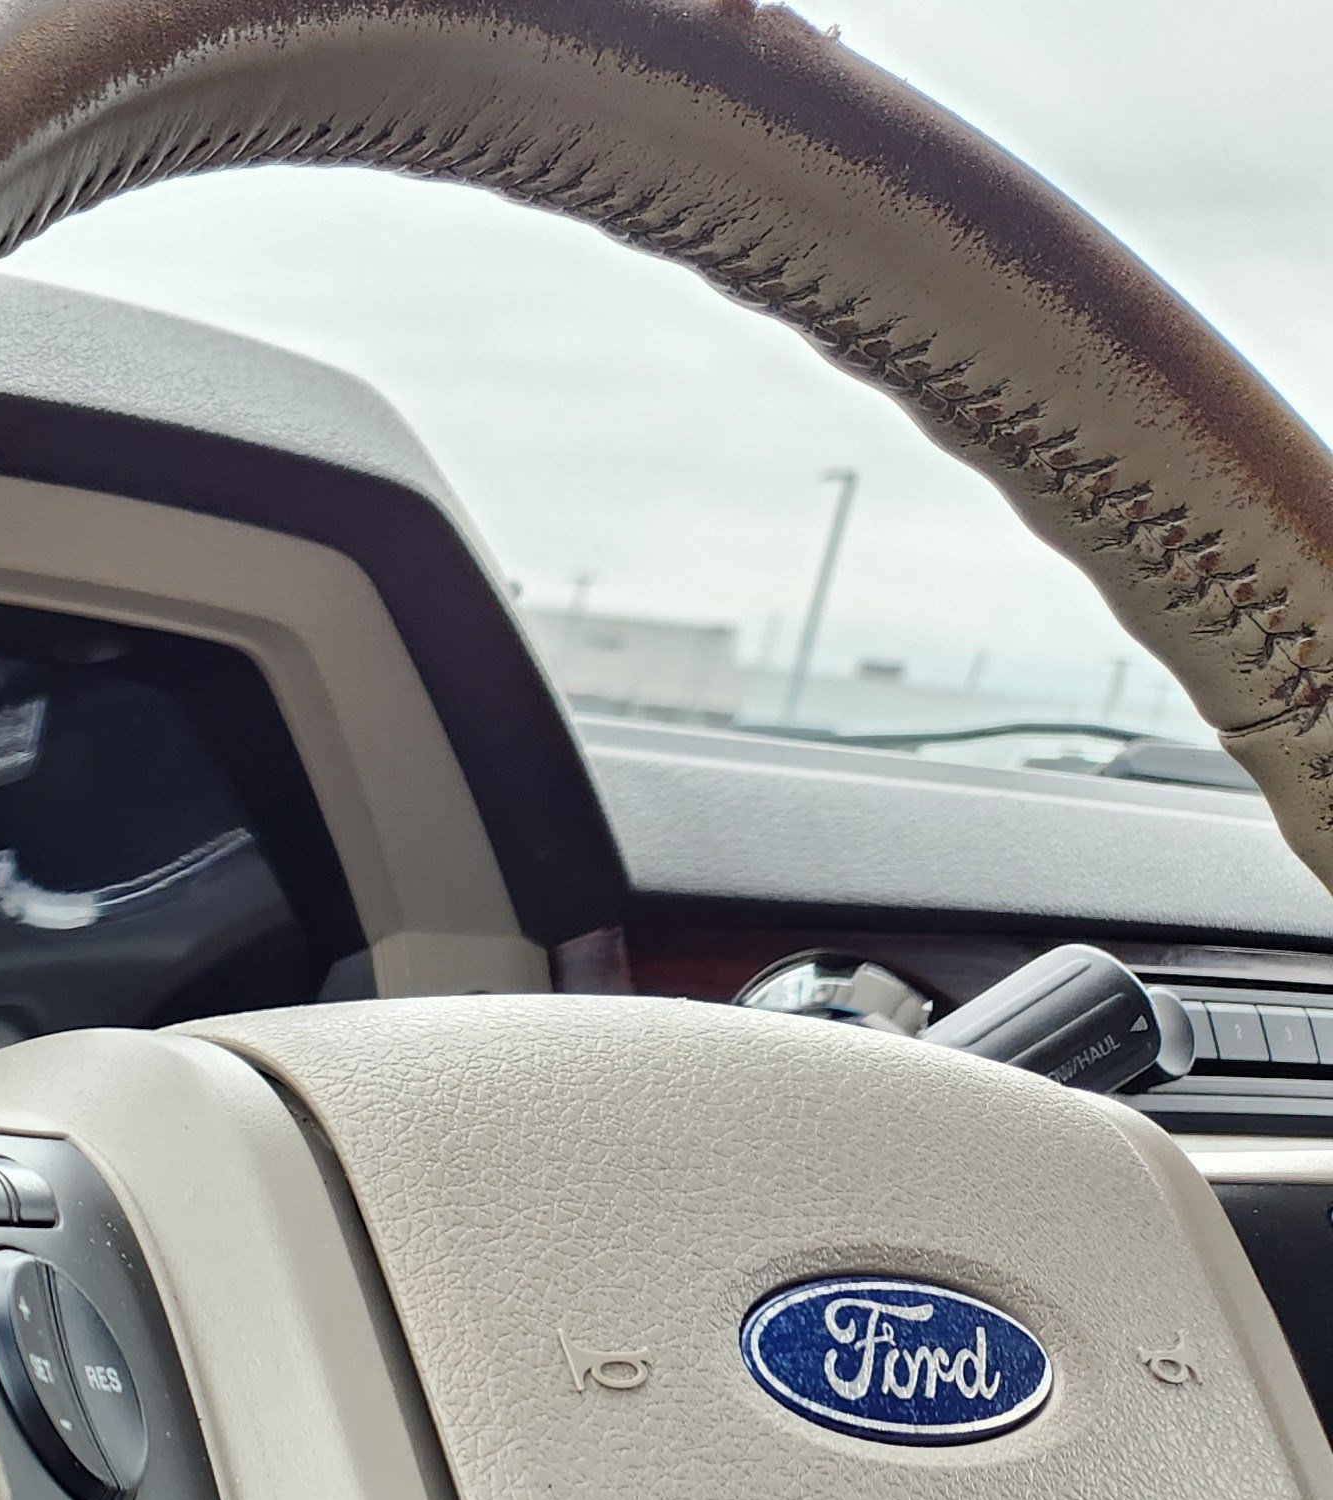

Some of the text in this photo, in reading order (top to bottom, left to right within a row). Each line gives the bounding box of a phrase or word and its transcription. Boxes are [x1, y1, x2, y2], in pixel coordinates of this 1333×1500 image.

[825, 1298, 1000, 1400] Ford
[29, 1352, 55, 1386] SET
[85, 1365, 123, 1394] RES
